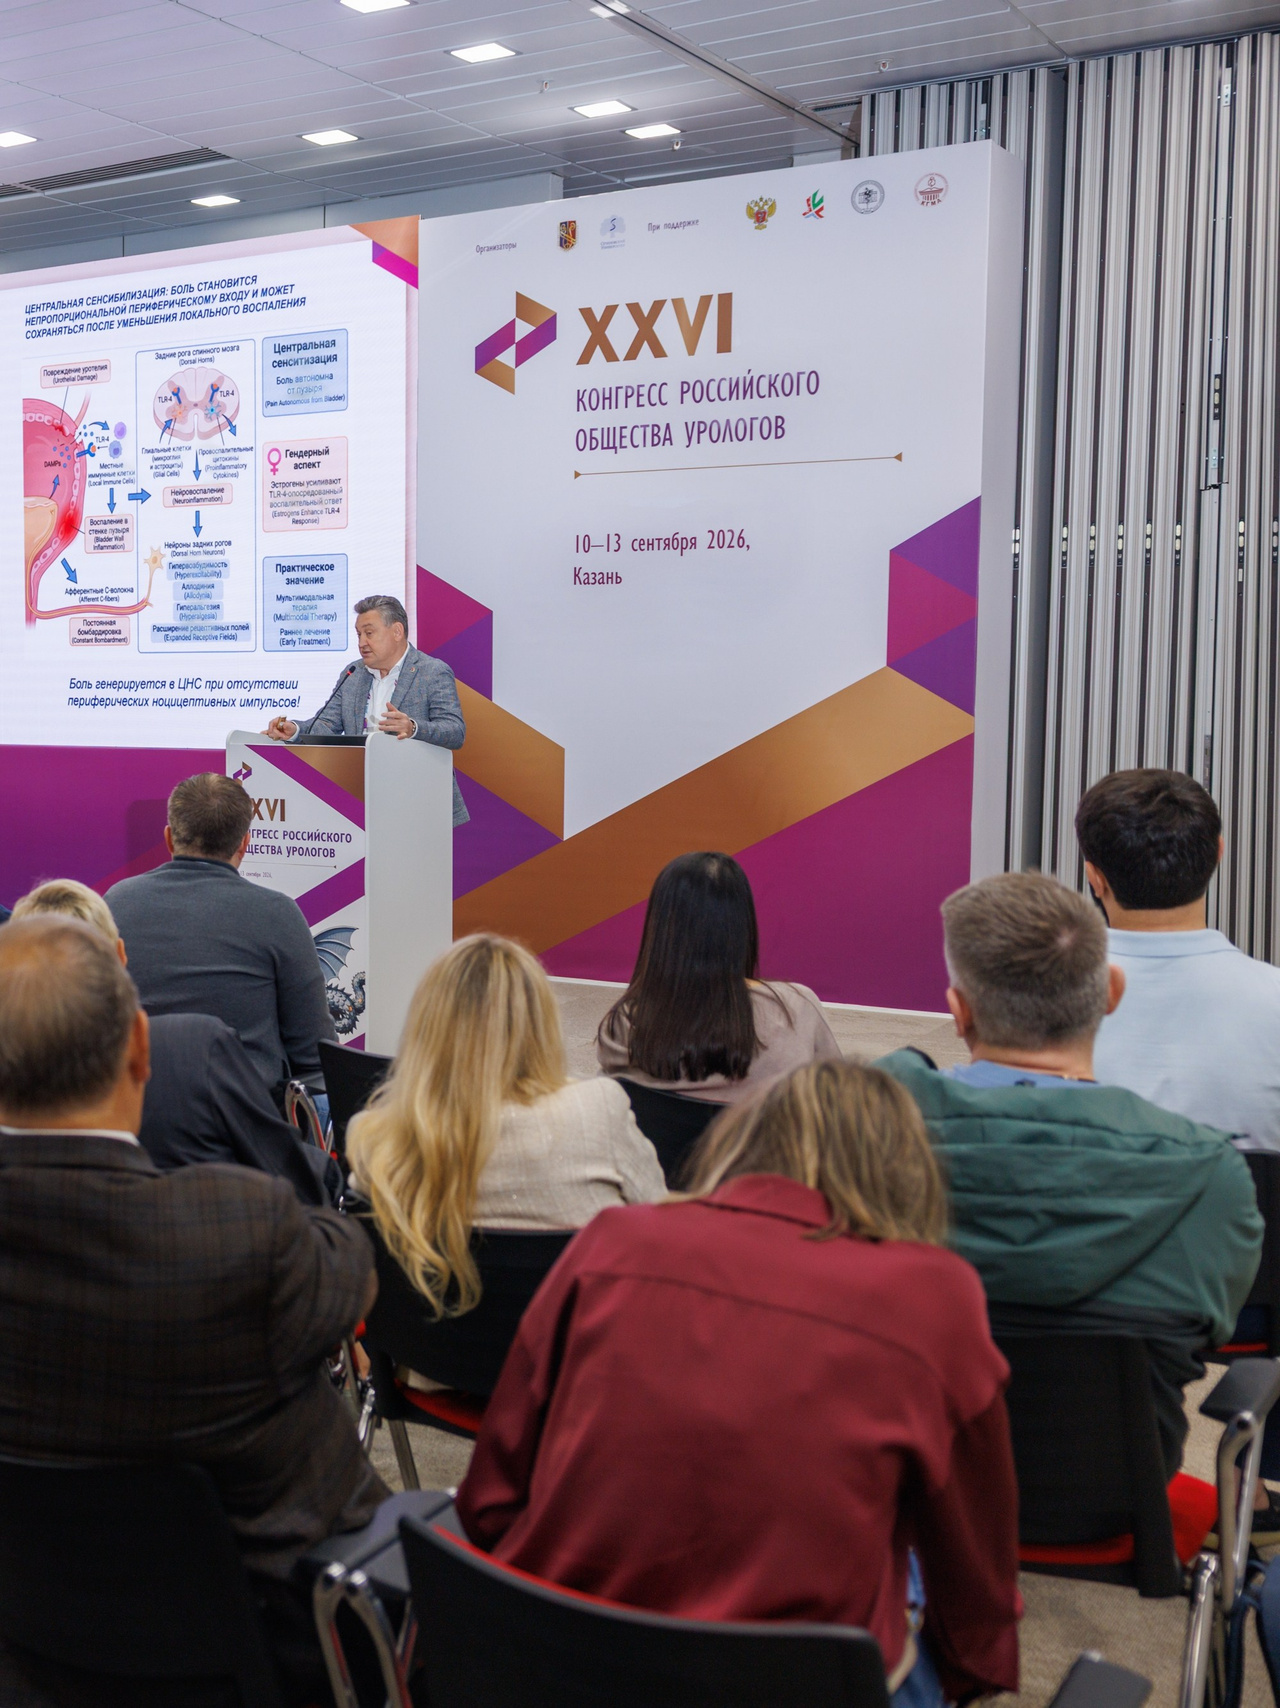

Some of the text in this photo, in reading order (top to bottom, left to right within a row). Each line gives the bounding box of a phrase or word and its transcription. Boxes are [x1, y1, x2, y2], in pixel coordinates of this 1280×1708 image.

[648, 218, 699, 232] При поддержке
[475, 242, 517, 254] Организаторы
[25, 275, 258, 315] ЦЕНТРАЛЬНАЯ СЕНСИБИЛИЗАЦИЯ: БОЛЬ СТАНОВИТСЯ
[25, 284, 295, 326] НЕПРОПОРЦИОНАЛЬНОЙ ПЕРИФЕРИЧЕСКОМУ ВХОДУ И МОЖЕТ
[25, 297, 306, 339] СОХРАНЯТЬСЯ ПОСЛЕ УМЕНЬШЕНИЯ ЛОКАЛЬНОГО ВОСПАЛЕНИЯ
[576, 292, 733, 366] XXVI
[273, 339, 336, 354] Центральная
[155, 352, 177, 360] Задние
[178, 350, 191, 358] рога
[192, 348, 220, 356] спинного
[179, 358, 197, 366] (Dorsal
[272, 353, 338, 368] сенситизация
[43, 364, 108, 377] Повреждение уротелия
[53, 374, 98, 385] (Urothelial Damage)
[276, 373, 334, 385] Боль автономна
[576, 369, 820, 412] КОНГРЕСС РОССИЙСКОГО
[265, 395, 345, 408] (Pain Bladder)
[575, 415, 786, 454] ОБЩЕСТВА УРОЛОГОВ
[142, 447, 172, 455] Глиальные
[199, 446, 253, 455] Провоспалительные
[285, 447, 330, 459] Гендерный
[205, 463, 247, 472] (Proinflammatory
[293, 461, 321, 470] аспект
[213, 471, 239, 479] Cytokines)
[122, 477, 135, 485] Cells)
[271, 478, 341, 489] Эстрогены усиливают
[171, 487, 225, 496] Нейровоспаление
[172, 495, 223, 505] (Neuroinflammation)
[272, 509, 300, 518] (Estrogens
[292, 517, 320, 525] Response)
[109, 527, 129, 535] пузыря
[165, 541, 191, 549] Нейроны
[214, 540, 232, 548] рогов
[631, 534, 698, 556] сентября
[707, 529, 750, 551] 2026,
[171, 550, 188, 558] (Dorsal
[169, 562, 228, 570] Гипервозбудимость
[275, 563, 335, 574] Практическое
[285, 576, 325, 585] значение
[573, 566, 623, 586] Казань
[65, 587, 104, 595] Афферентные
[79, 595, 99, 603] (Afferent
[276, 594, 334, 603] Мультимодальная
[83, 619, 116, 627] Постоянная
[153, 624, 189, 633] Расширение
[231, 623, 250, 631] полей
[78, 628, 121, 636] бомбардировка
[72, 635, 128, 644] (Constant Bombardment)
[164, 633, 192, 642] (Expanded
[193, 633, 219, 641] Receptive
[280, 637, 331, 647] (Early Treatment)
[69, 677, 298, 693] Боль генерируется в ЦНС при отсутствии
[68, 696, 300, 710] периферических ноцицептивных импульсов!
[250, 798, 286, 822] XVI
[249, 829, 352, 843] ГРЕСС РОССИЙСКОГО
[246, 845, 336, 858] ЩЕСТВА УРОЛОГОВ
